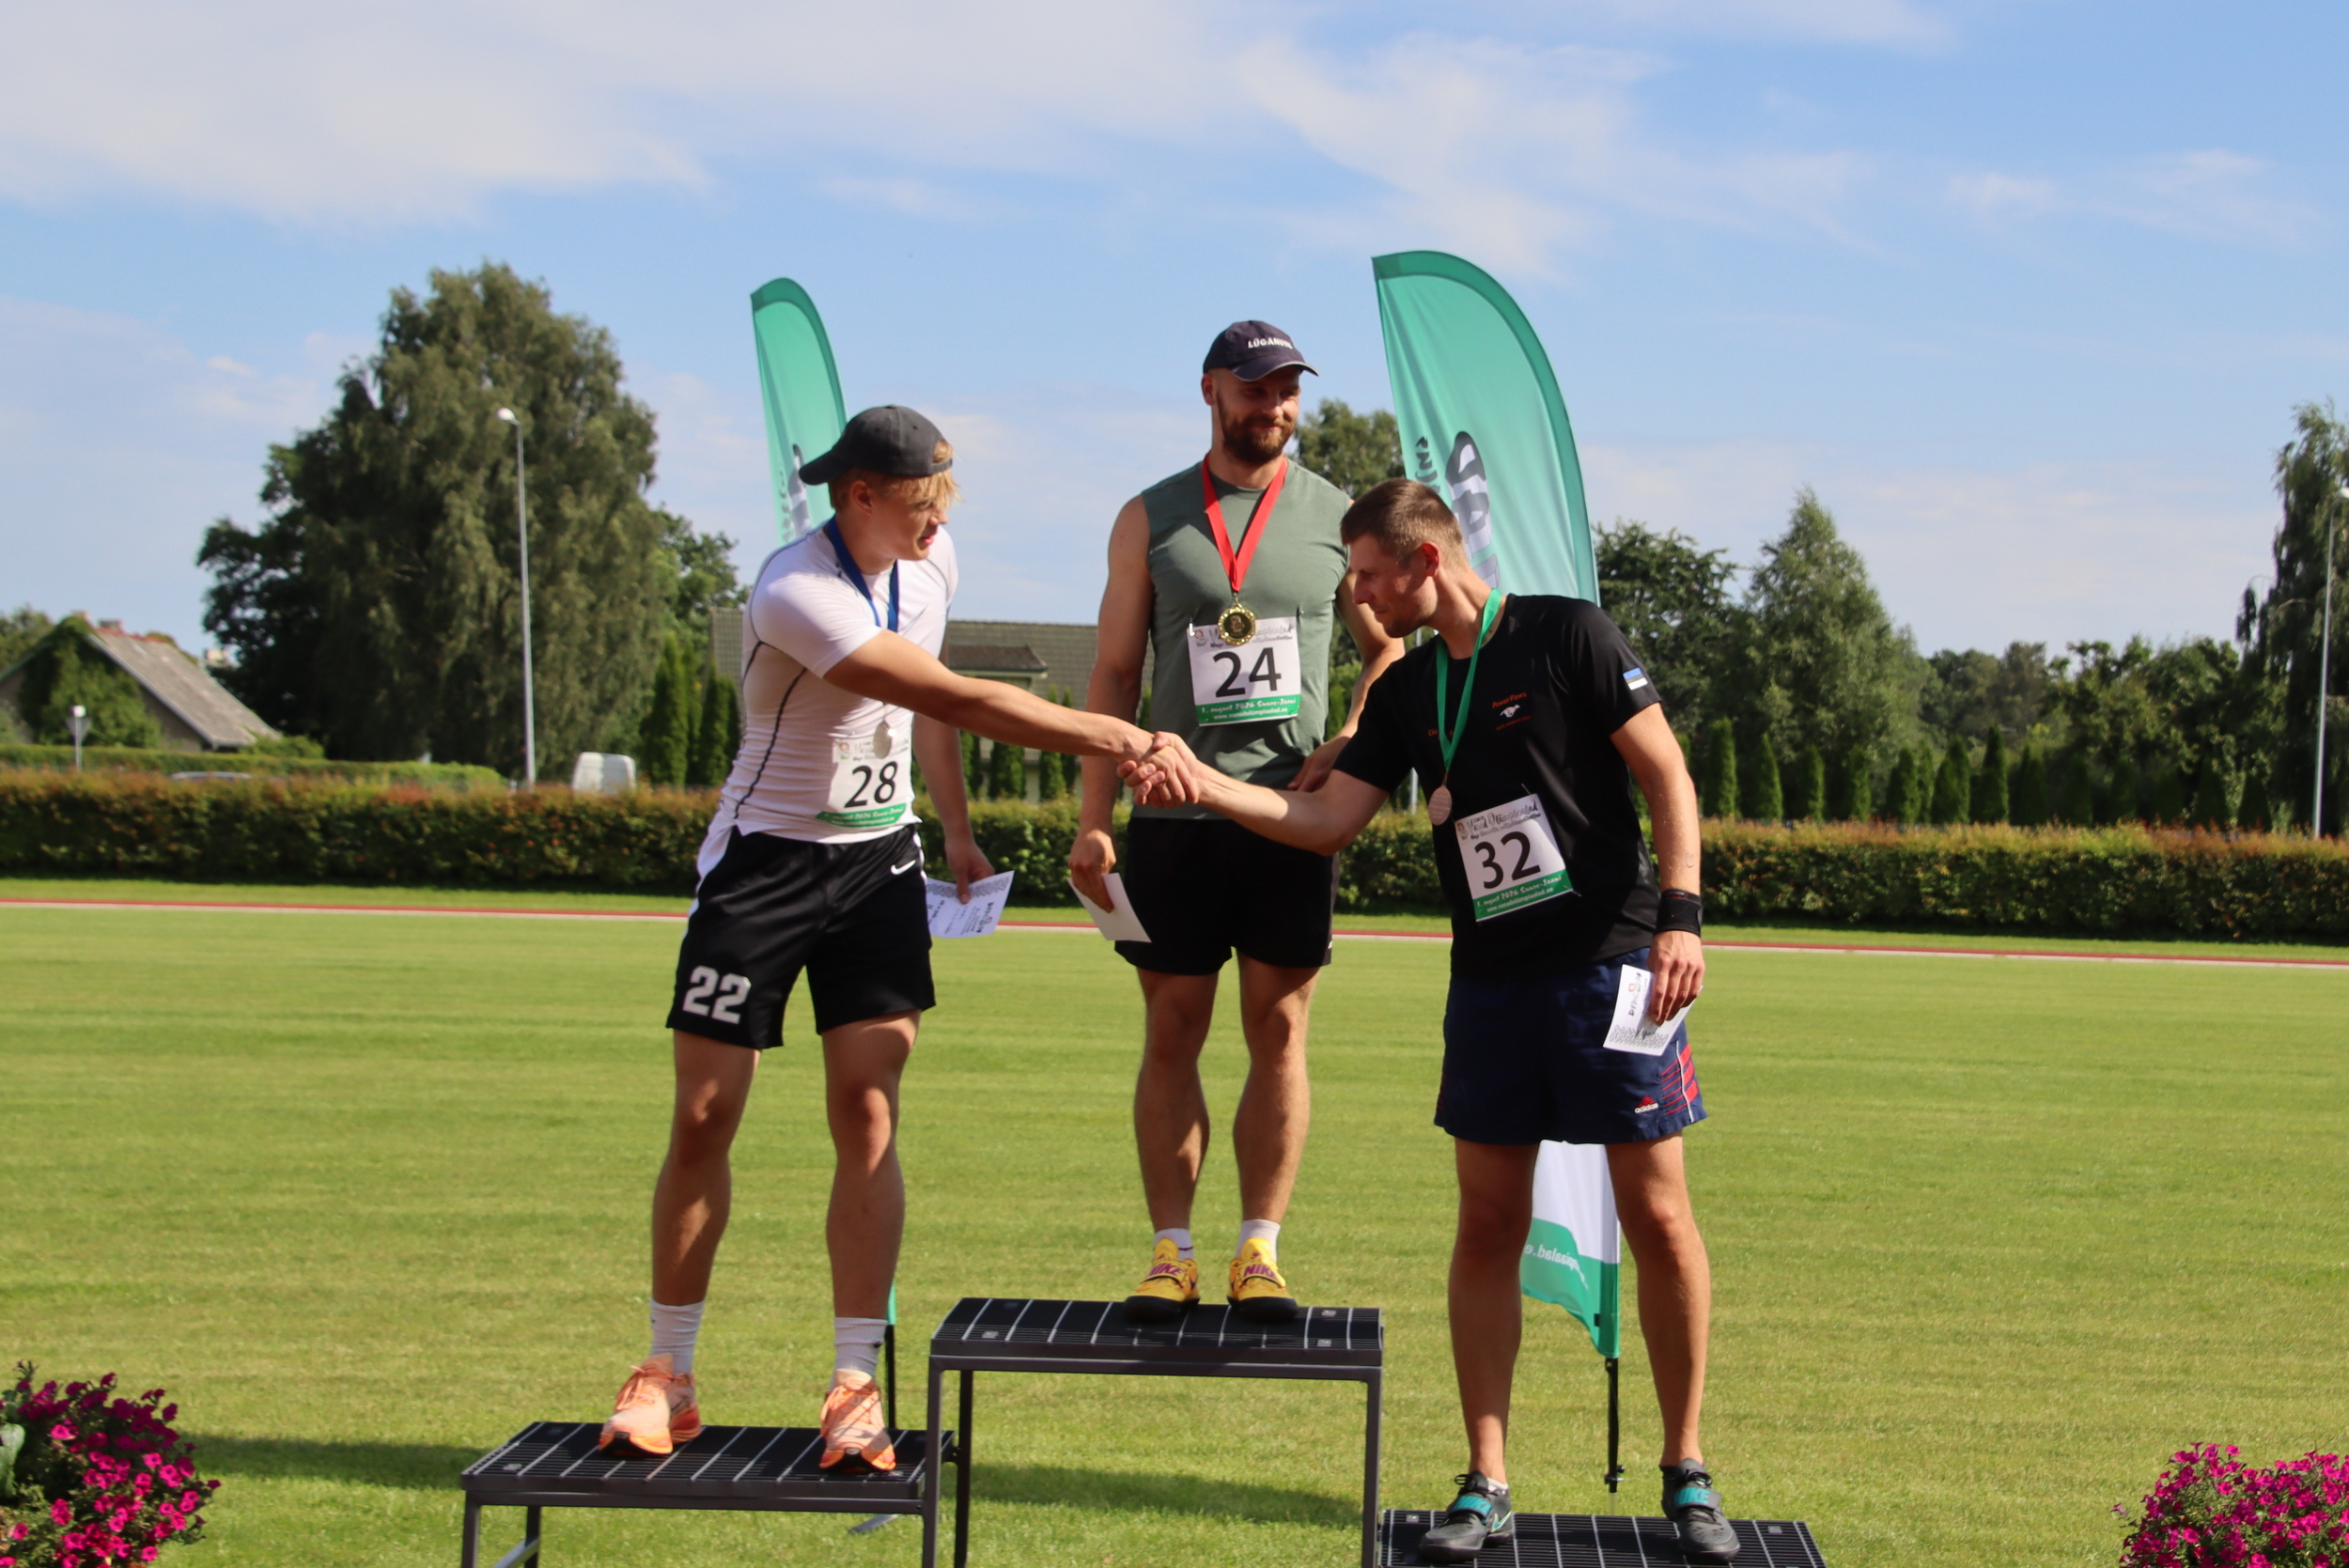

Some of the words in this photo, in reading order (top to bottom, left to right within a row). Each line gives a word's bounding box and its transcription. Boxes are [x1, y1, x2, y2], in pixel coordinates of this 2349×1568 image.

[1212, 646, 1282, 698] 24
[1235, 702, 1254, 710] 2026
[844, 760, 898, 809] 28
[1473, 831, 1541, 890] 32
[1501, 890, 1518, 900] 2026
[682, 964, 752, 1025] 22
[1674, 1486, 1711, 1507] NIKE
